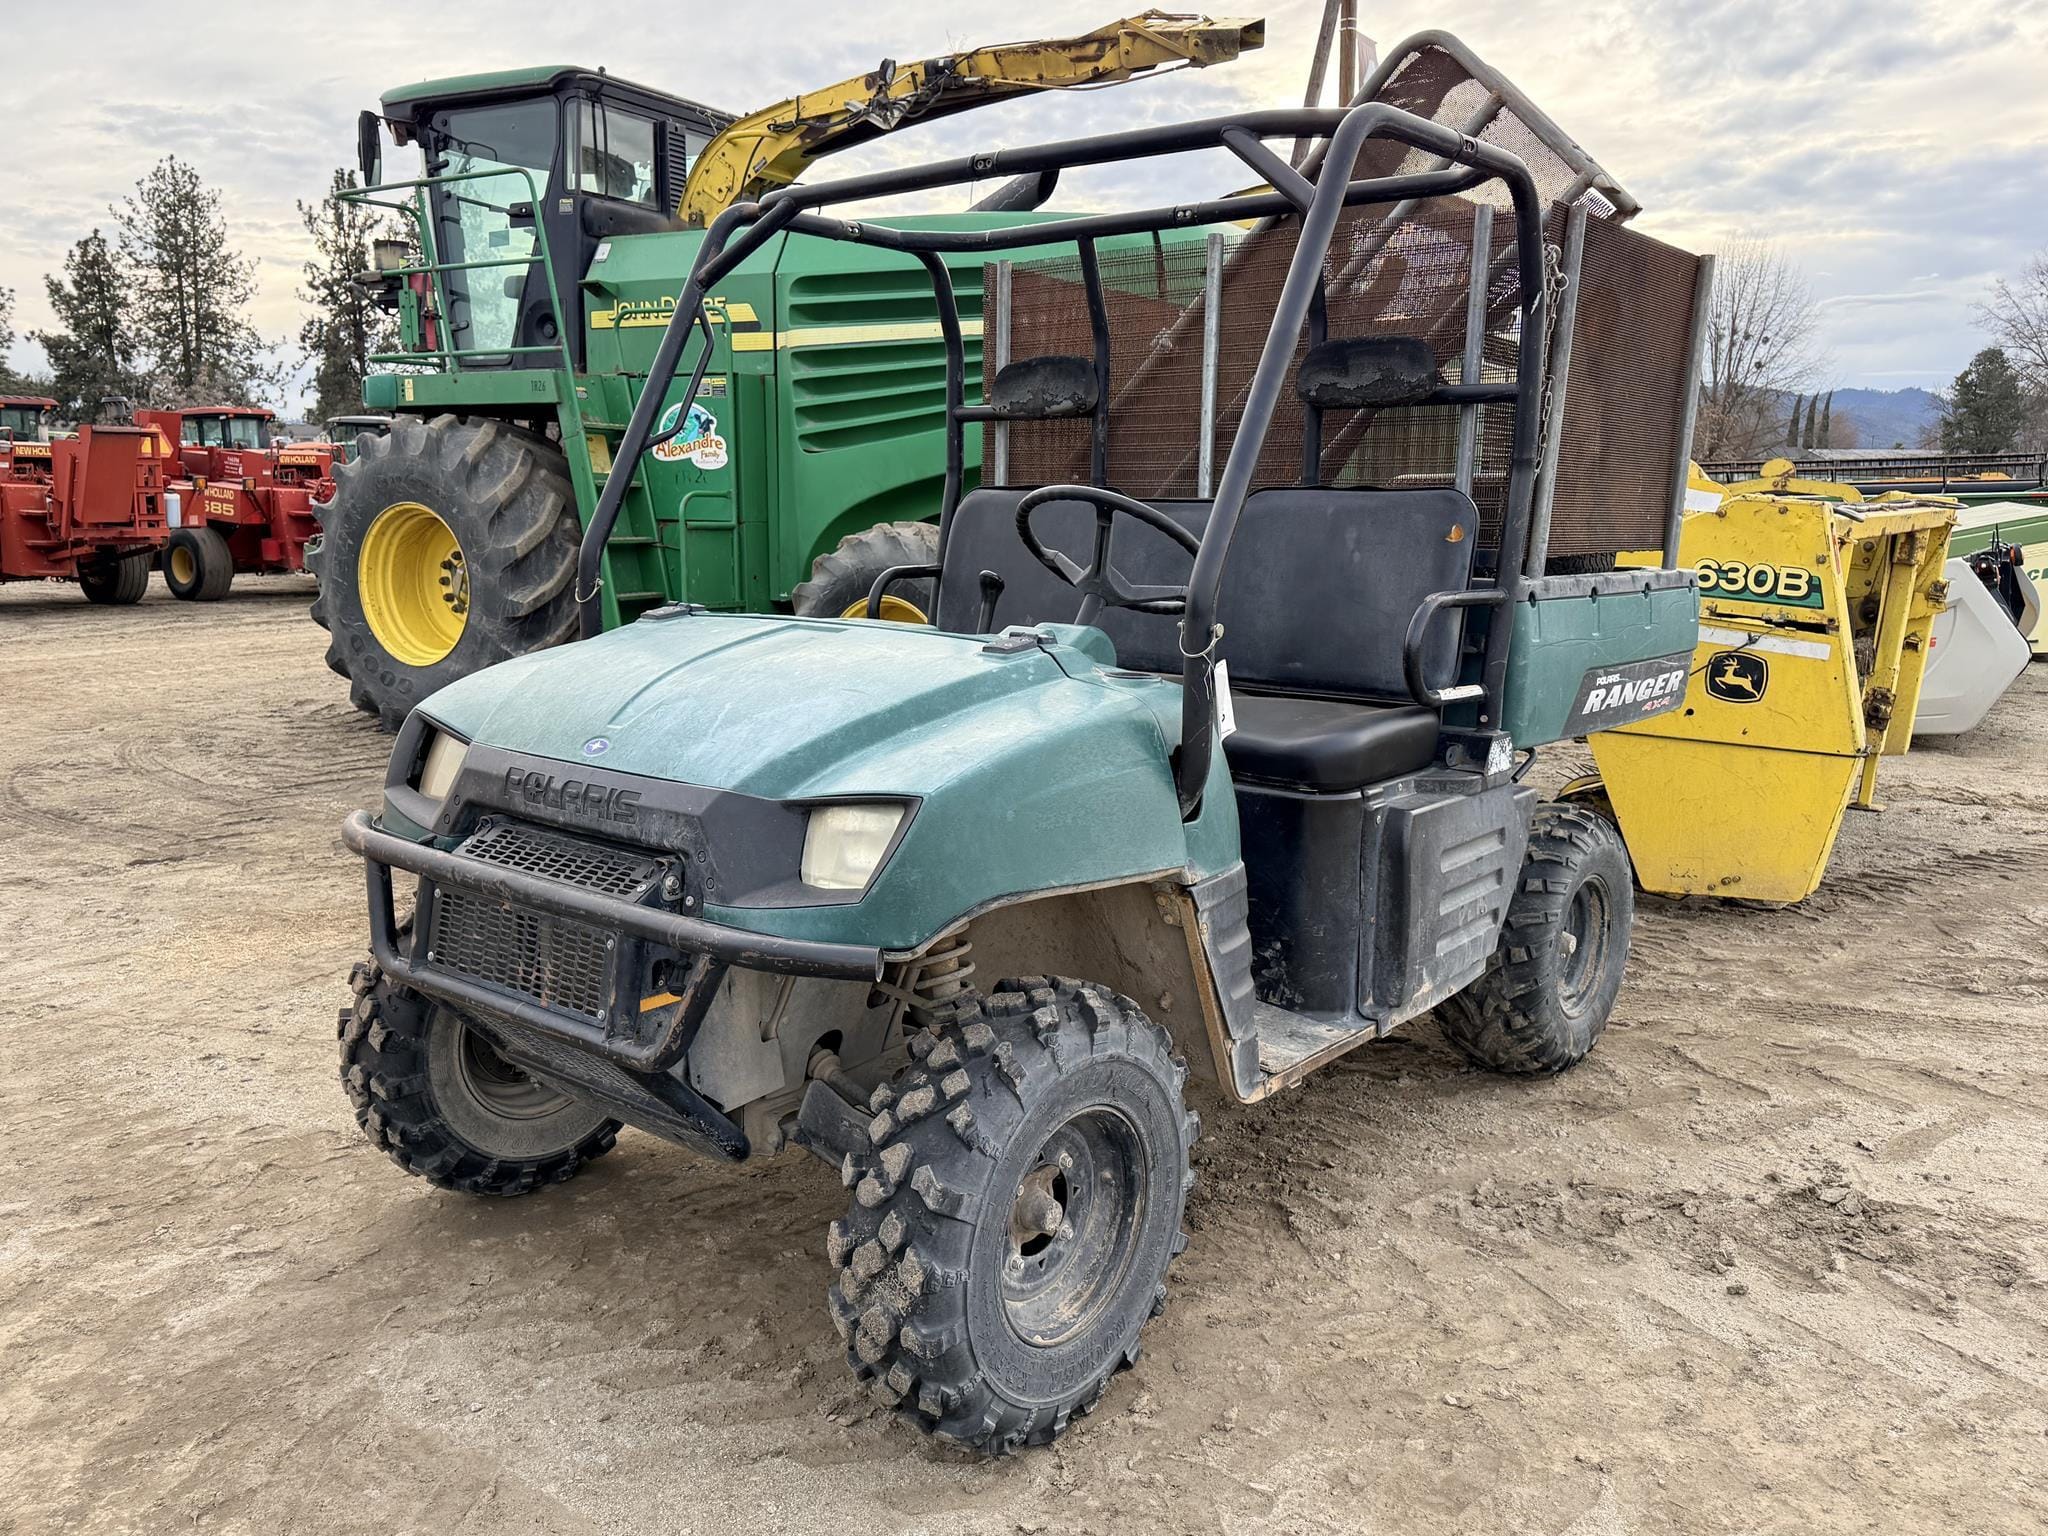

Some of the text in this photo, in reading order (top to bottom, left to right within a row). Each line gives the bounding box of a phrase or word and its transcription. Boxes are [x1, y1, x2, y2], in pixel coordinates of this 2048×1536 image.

[608, 296, 726, 320] JOHN DRE
[15, 446, 52, 456] NEW HOLL
[656, 433, 723, 458] Alexandre
[291, 455, 317, 464] HOLLAND
[210, 487, 234, 500] HOLLAND
[1694, 558, 1812, 599] 630B
[1596, 673, 1621, 686] POLARIS
[1582, 670, 1684, 715] RANGER
[504, 766, 642, 825] POLARIS
